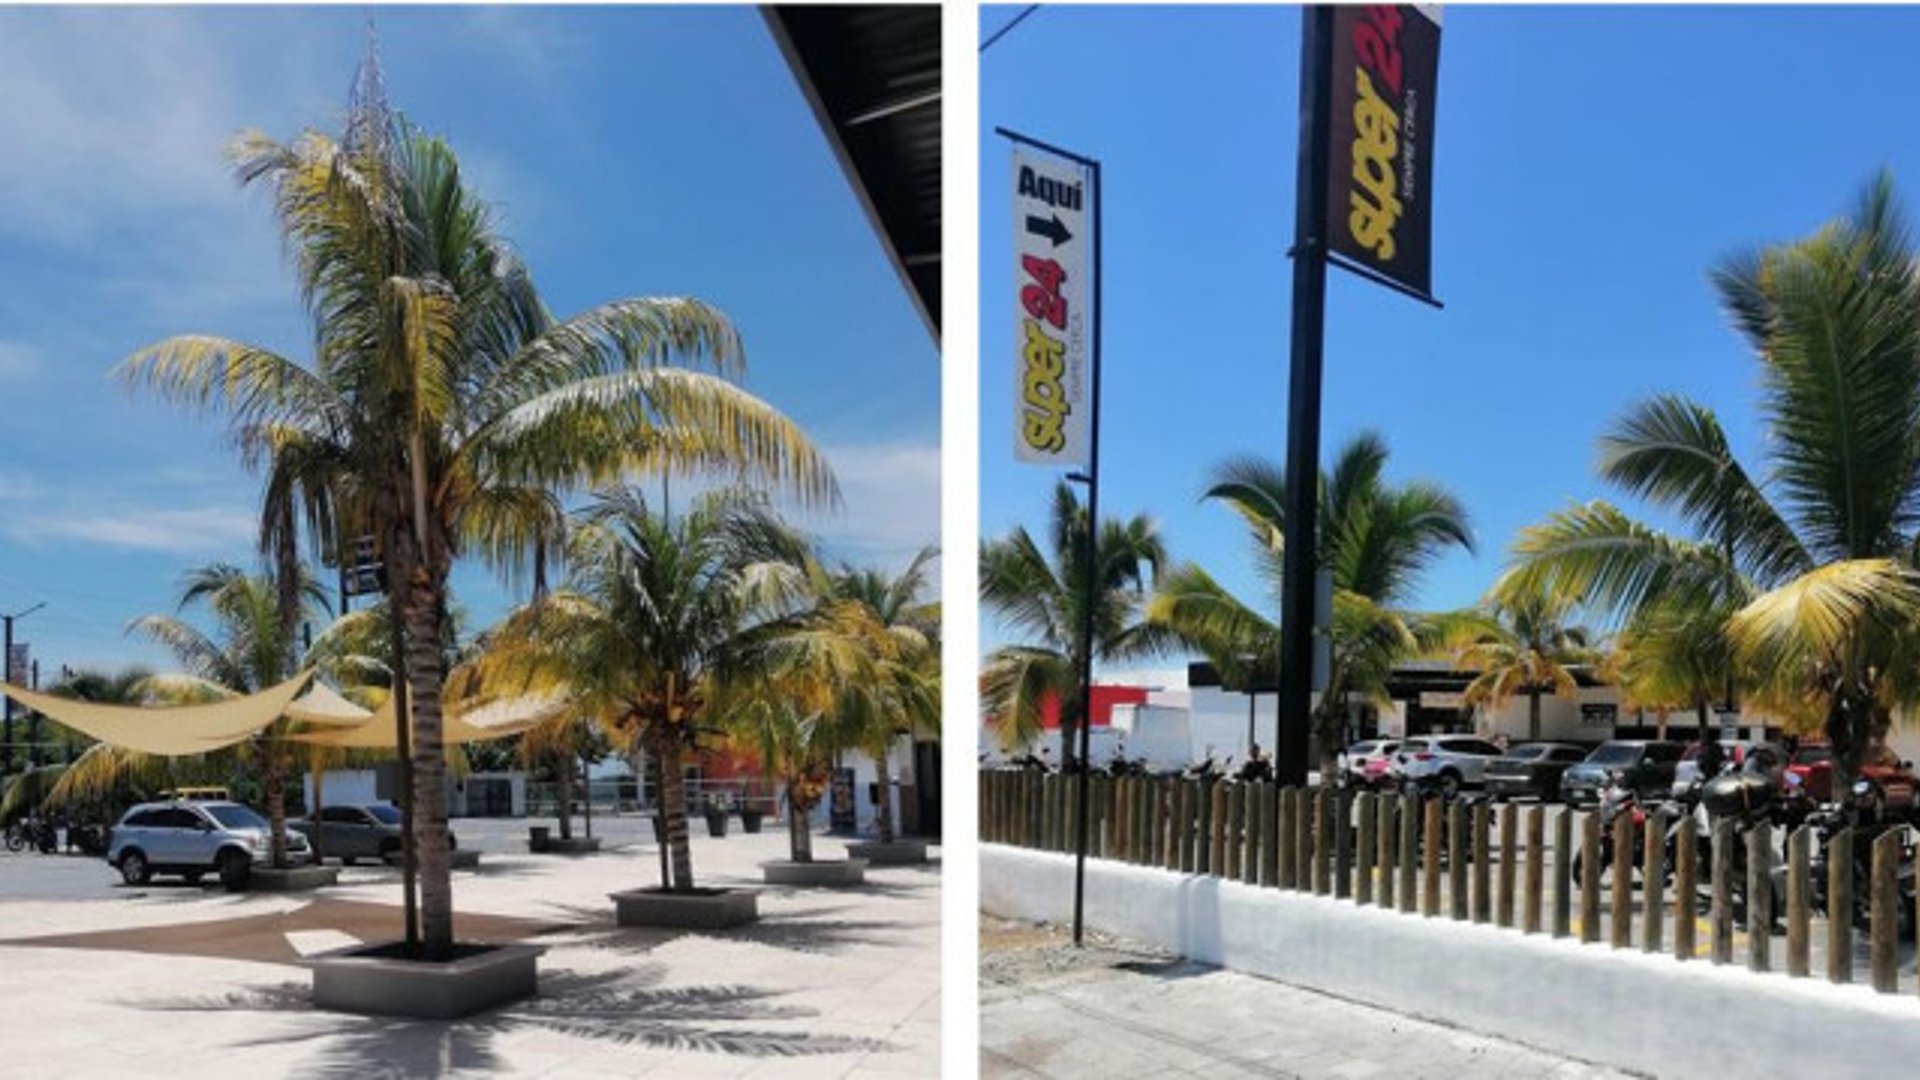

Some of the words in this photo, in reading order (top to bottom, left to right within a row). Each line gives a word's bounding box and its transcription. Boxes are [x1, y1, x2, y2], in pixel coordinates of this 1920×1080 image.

[1018, 165, 1083, 211] Aquí
[1349, 65, 1401, 260] super
[1020, 253, 1068, 330] 24
[1022, 318, 1071, 453] super
